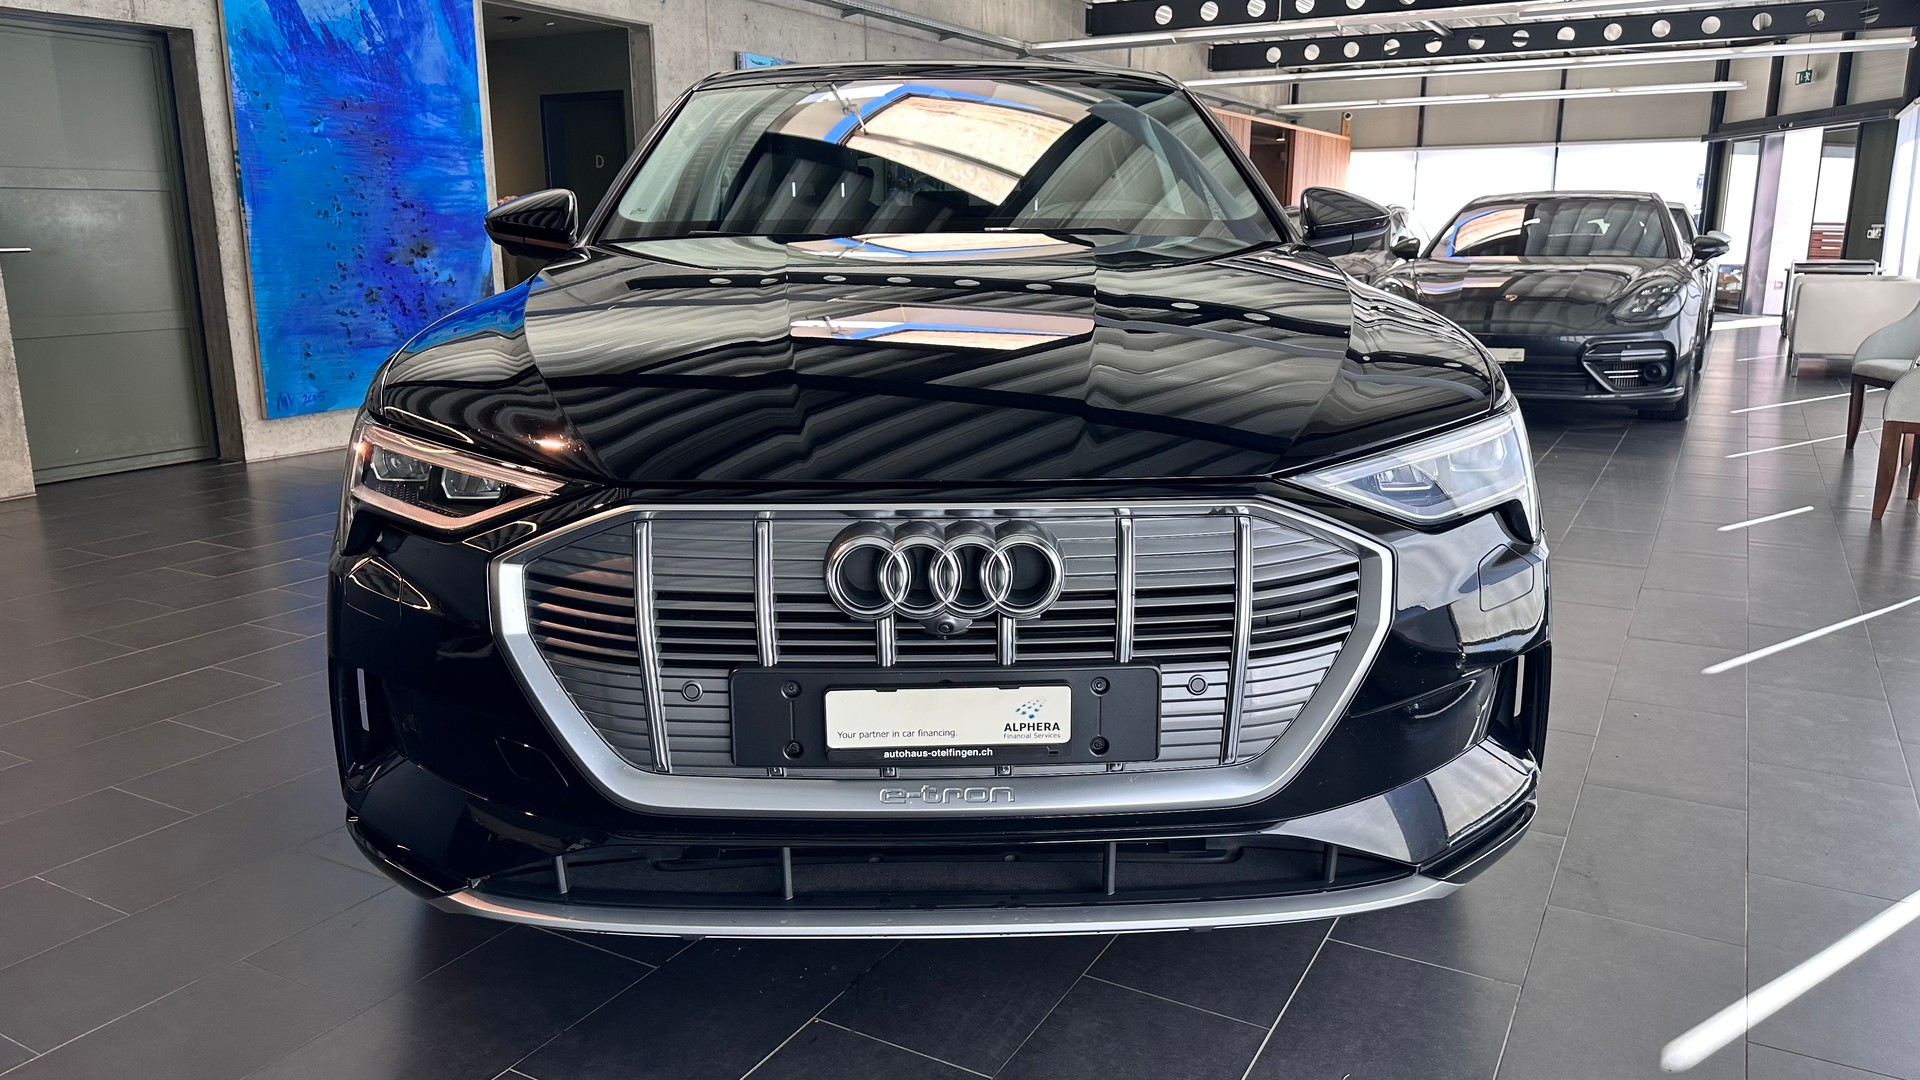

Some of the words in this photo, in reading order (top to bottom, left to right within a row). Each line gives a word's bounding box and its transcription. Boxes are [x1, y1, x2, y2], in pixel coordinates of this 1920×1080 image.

[595, 154, 605, 169] D
[1004, 722, 1060, 732] ALPHERA
[837, 731, 856, 739] Your
[859, 730, 889, 740] partner
[892, 729, 900, 738] in
[902, 729, 915, 738] car
[918, 728, 958, 738] financing.
[883, 748, 994, 759] autohaus-otelfingen.ch
[879, 785, 1016, 804] e-tron
